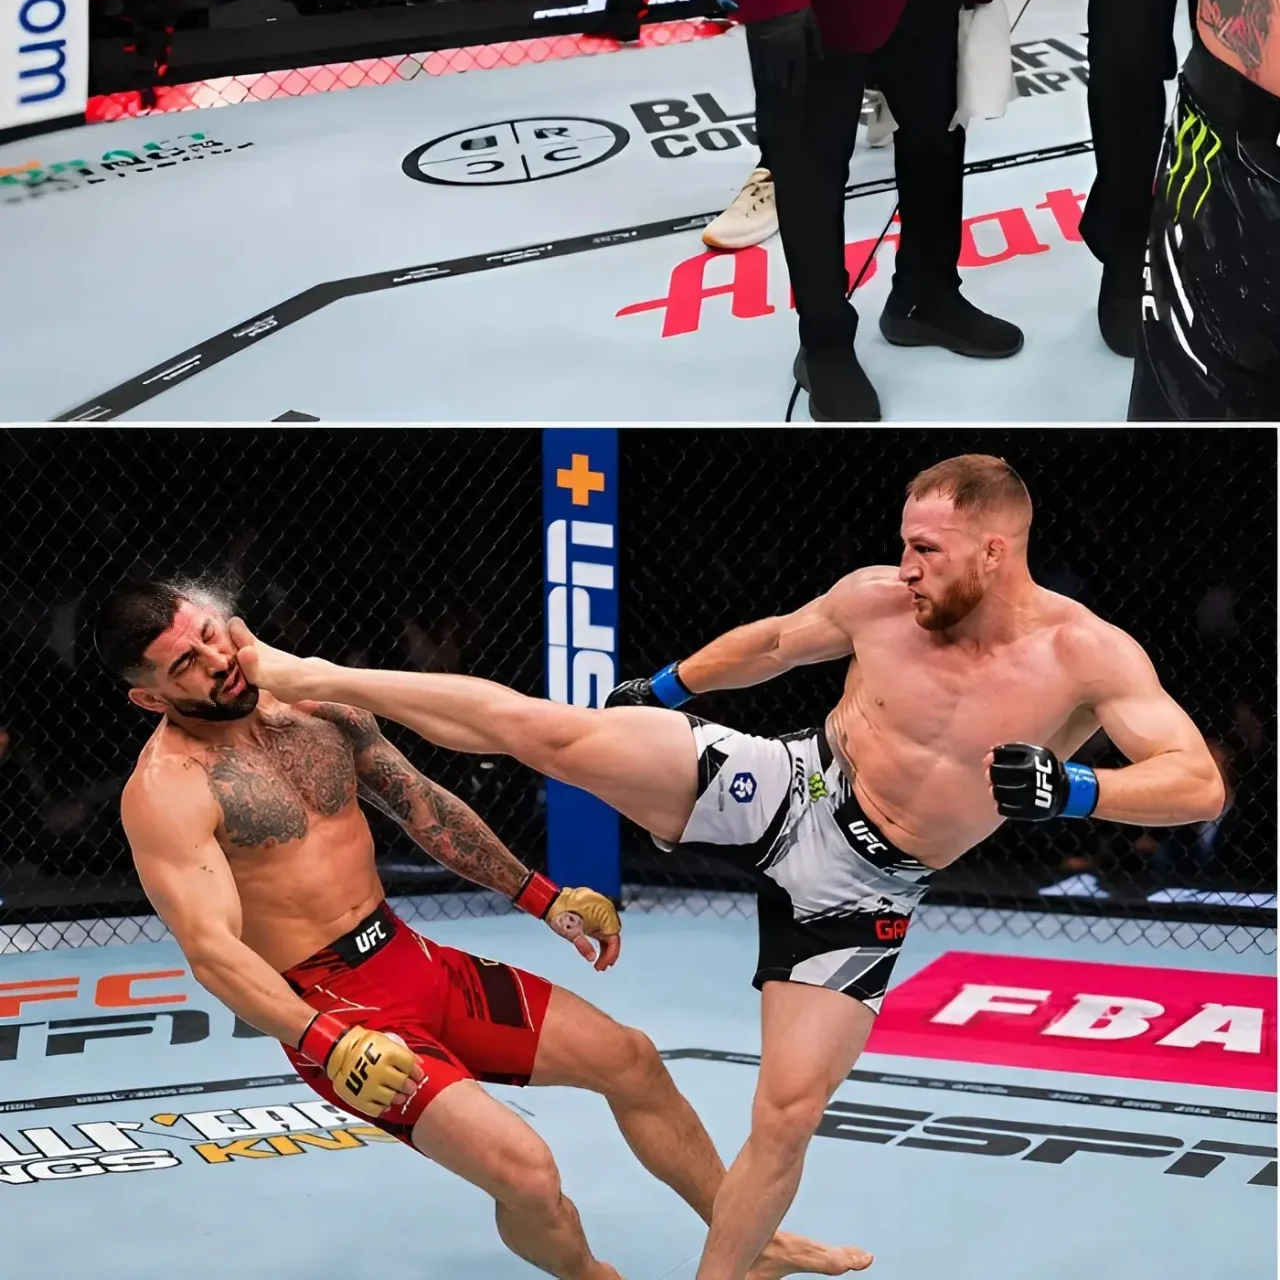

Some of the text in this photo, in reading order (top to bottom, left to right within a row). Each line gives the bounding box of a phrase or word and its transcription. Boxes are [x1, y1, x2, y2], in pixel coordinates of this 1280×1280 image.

[630, 92, 756, 135] BL
[546, 453, 615, 709] SPN+
[1034, 755, 1053, 809] UFC
[848, 820, 888, 855] UFC
[355, 920, 387, 954] UFC
[929, 983, 1264, 1054] FBA
[345, 1042, 382, 1097] UFC
